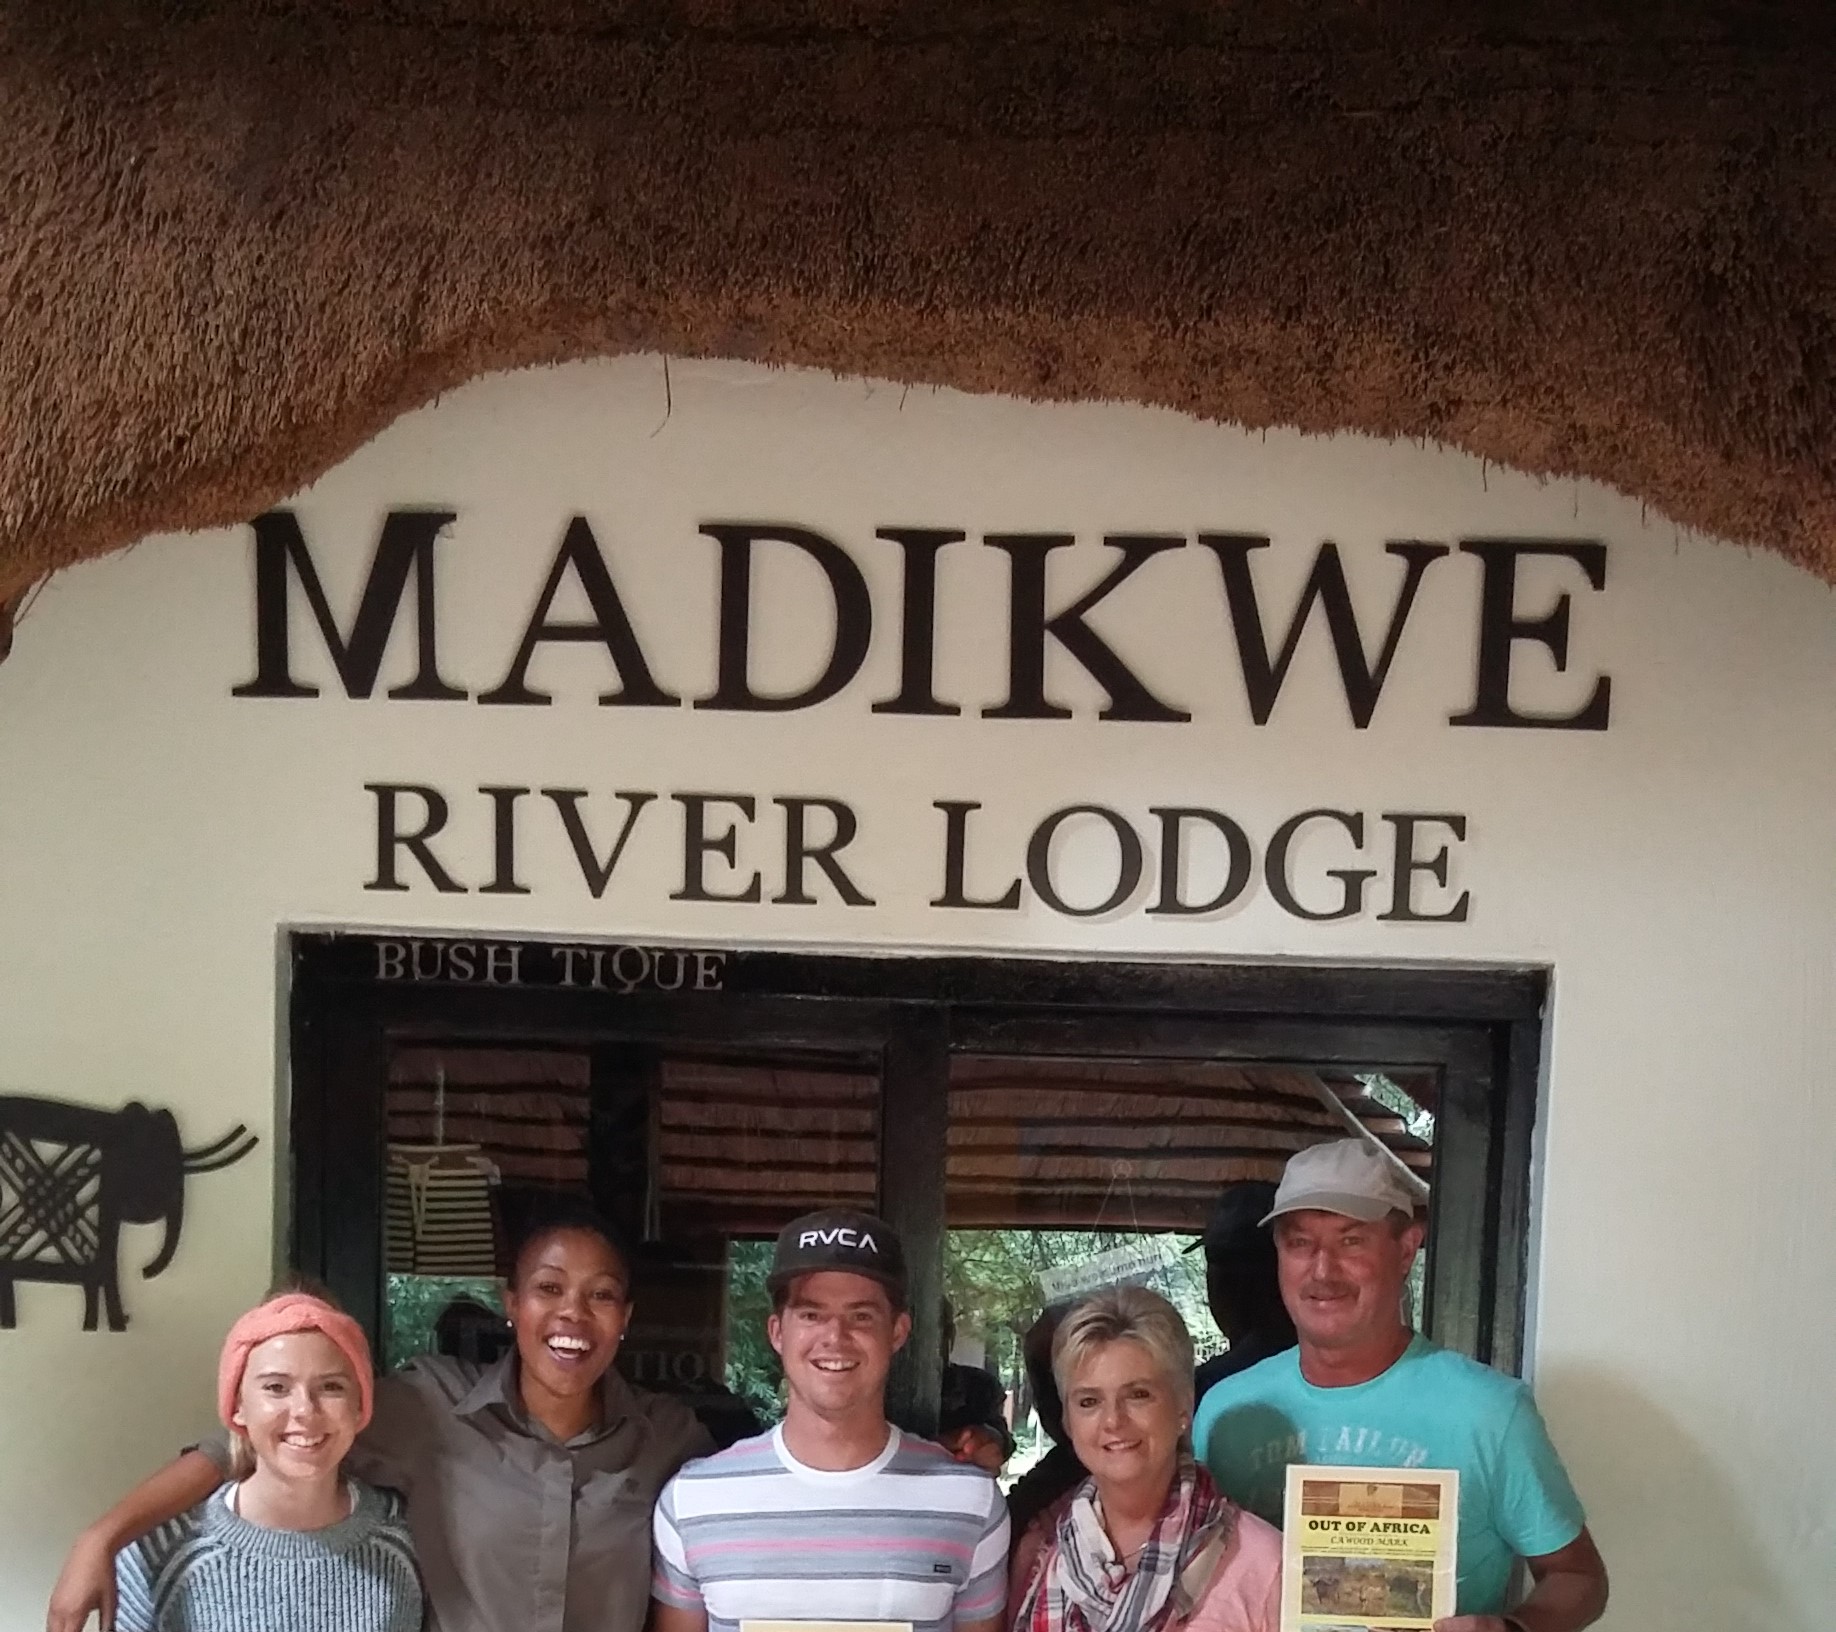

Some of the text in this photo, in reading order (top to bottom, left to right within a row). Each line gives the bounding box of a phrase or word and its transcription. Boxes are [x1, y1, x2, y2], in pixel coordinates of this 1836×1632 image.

[231, 511, 1611, 732] MADIKWE
[363, 782, 1470, 922] RIVER LODGE
[375, 941, 727, 994] BUSH TIQUE
[798, 1227, 879, 1254] RVCA
[1308, 1520, 1431, 1535] OUT OF AFRICA
